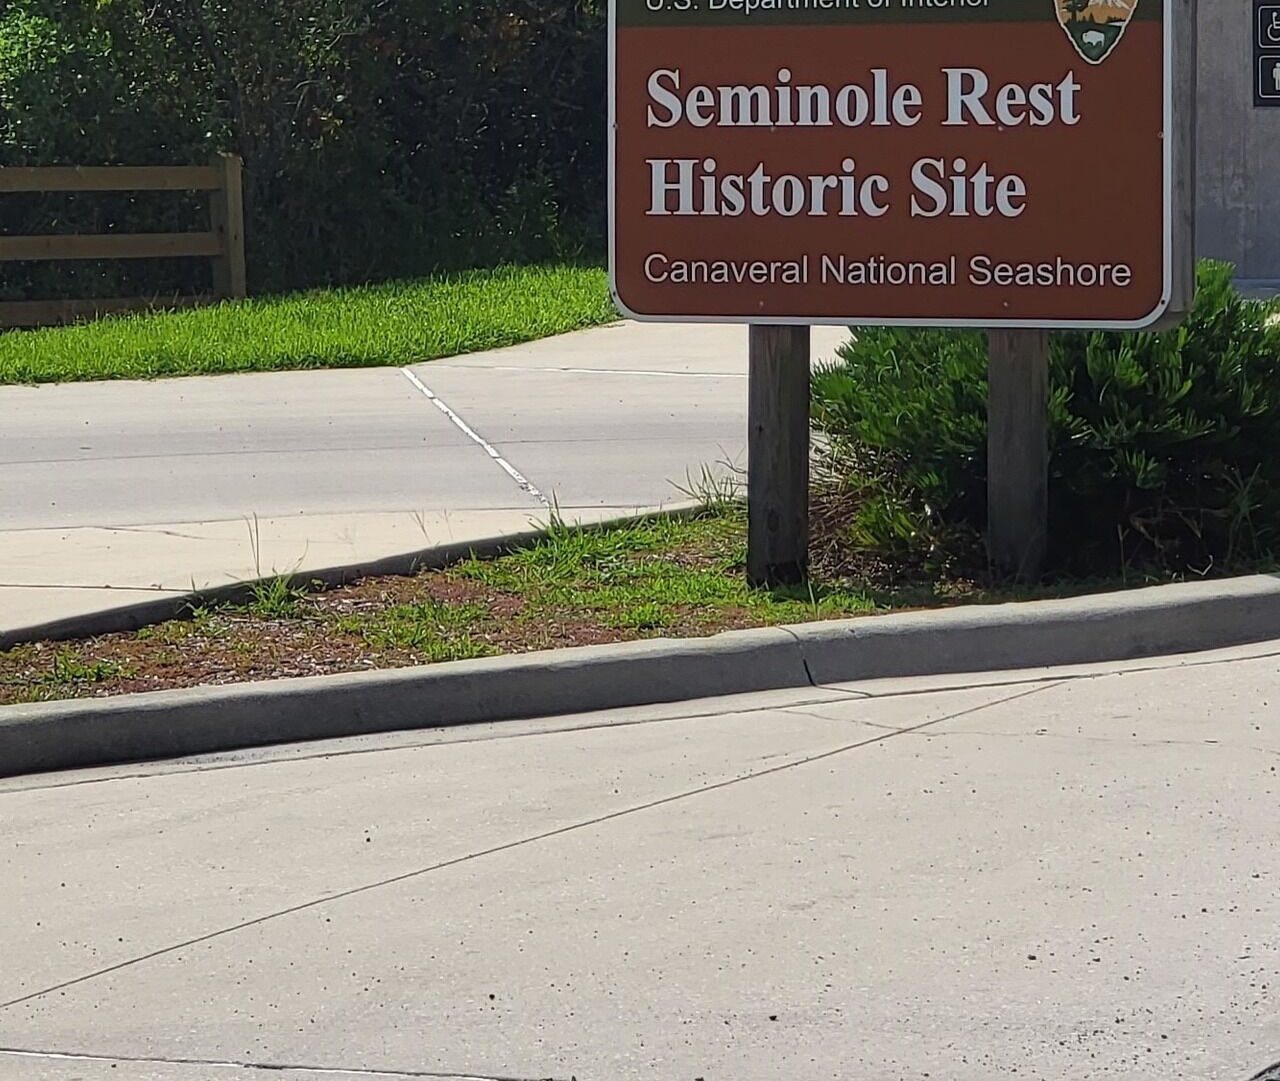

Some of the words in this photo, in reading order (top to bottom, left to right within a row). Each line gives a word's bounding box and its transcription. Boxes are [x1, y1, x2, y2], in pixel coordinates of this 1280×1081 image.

[646, 68, 923, 128] Seminole
[941, 67, 1081, 127] Rest
[645, 158, 890, 217] Historic
[910, 157, 1027, 217] Site
[644, 253, 808, 284] Canaveral
[821, 255, 956, 285] National
[968, 255, 1132, 287] Seashore
